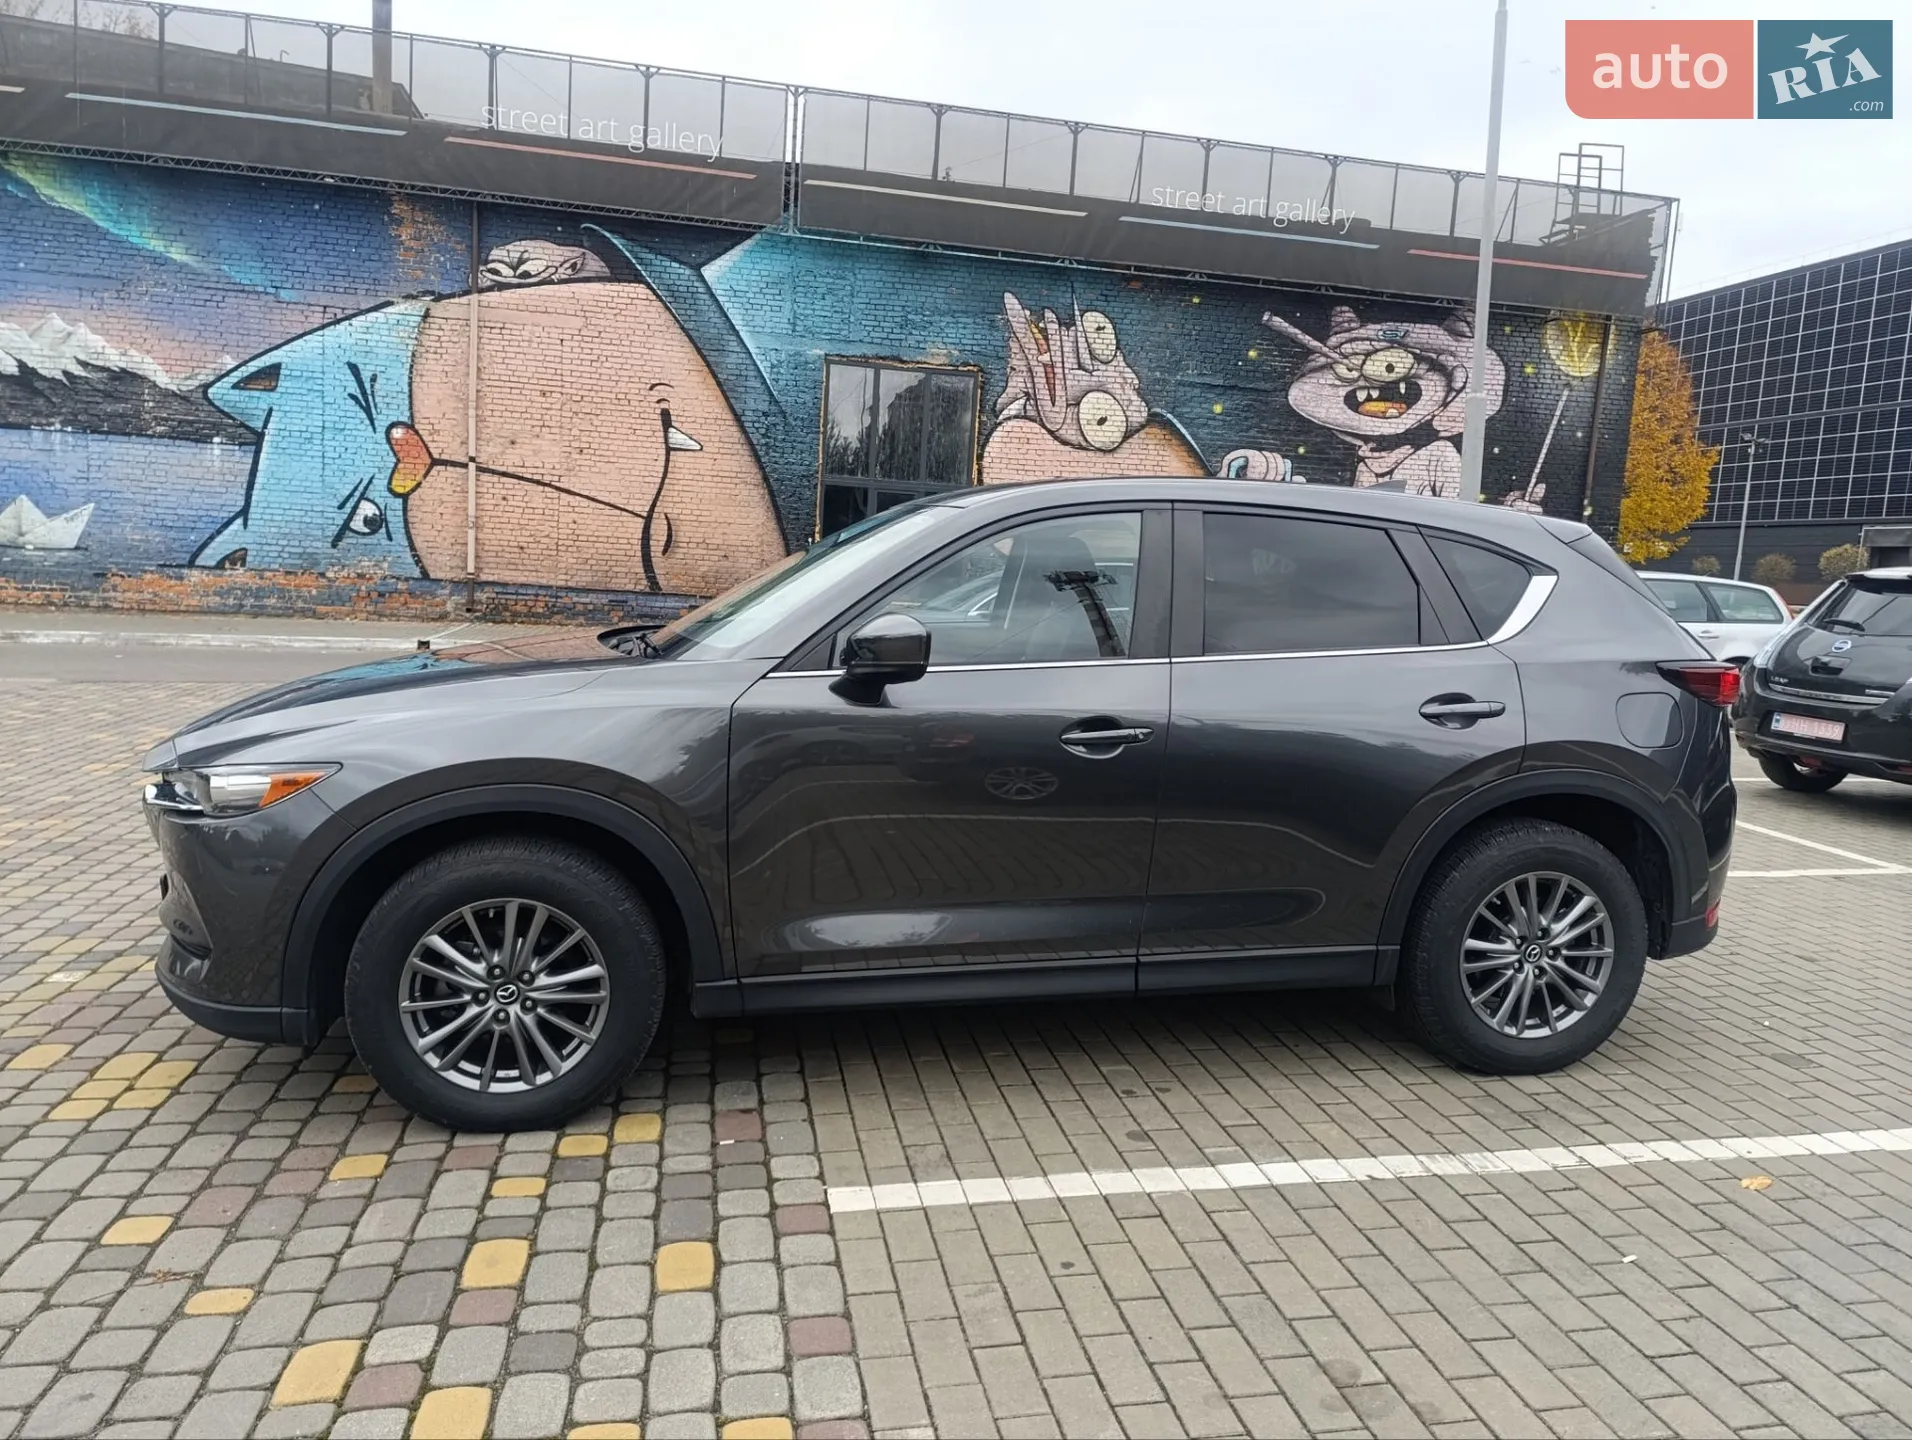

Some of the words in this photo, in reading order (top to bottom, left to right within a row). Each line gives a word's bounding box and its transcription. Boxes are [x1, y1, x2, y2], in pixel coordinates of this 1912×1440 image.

[481, 104, 569, 136] street
[578, 118, 619, 143] art
[627, 121, 724, 163] gallery
[1151, 185, 1226, 214] street
[1232, 195, 1268, 219] art
[1273, 198, 1355, 235] gallery
